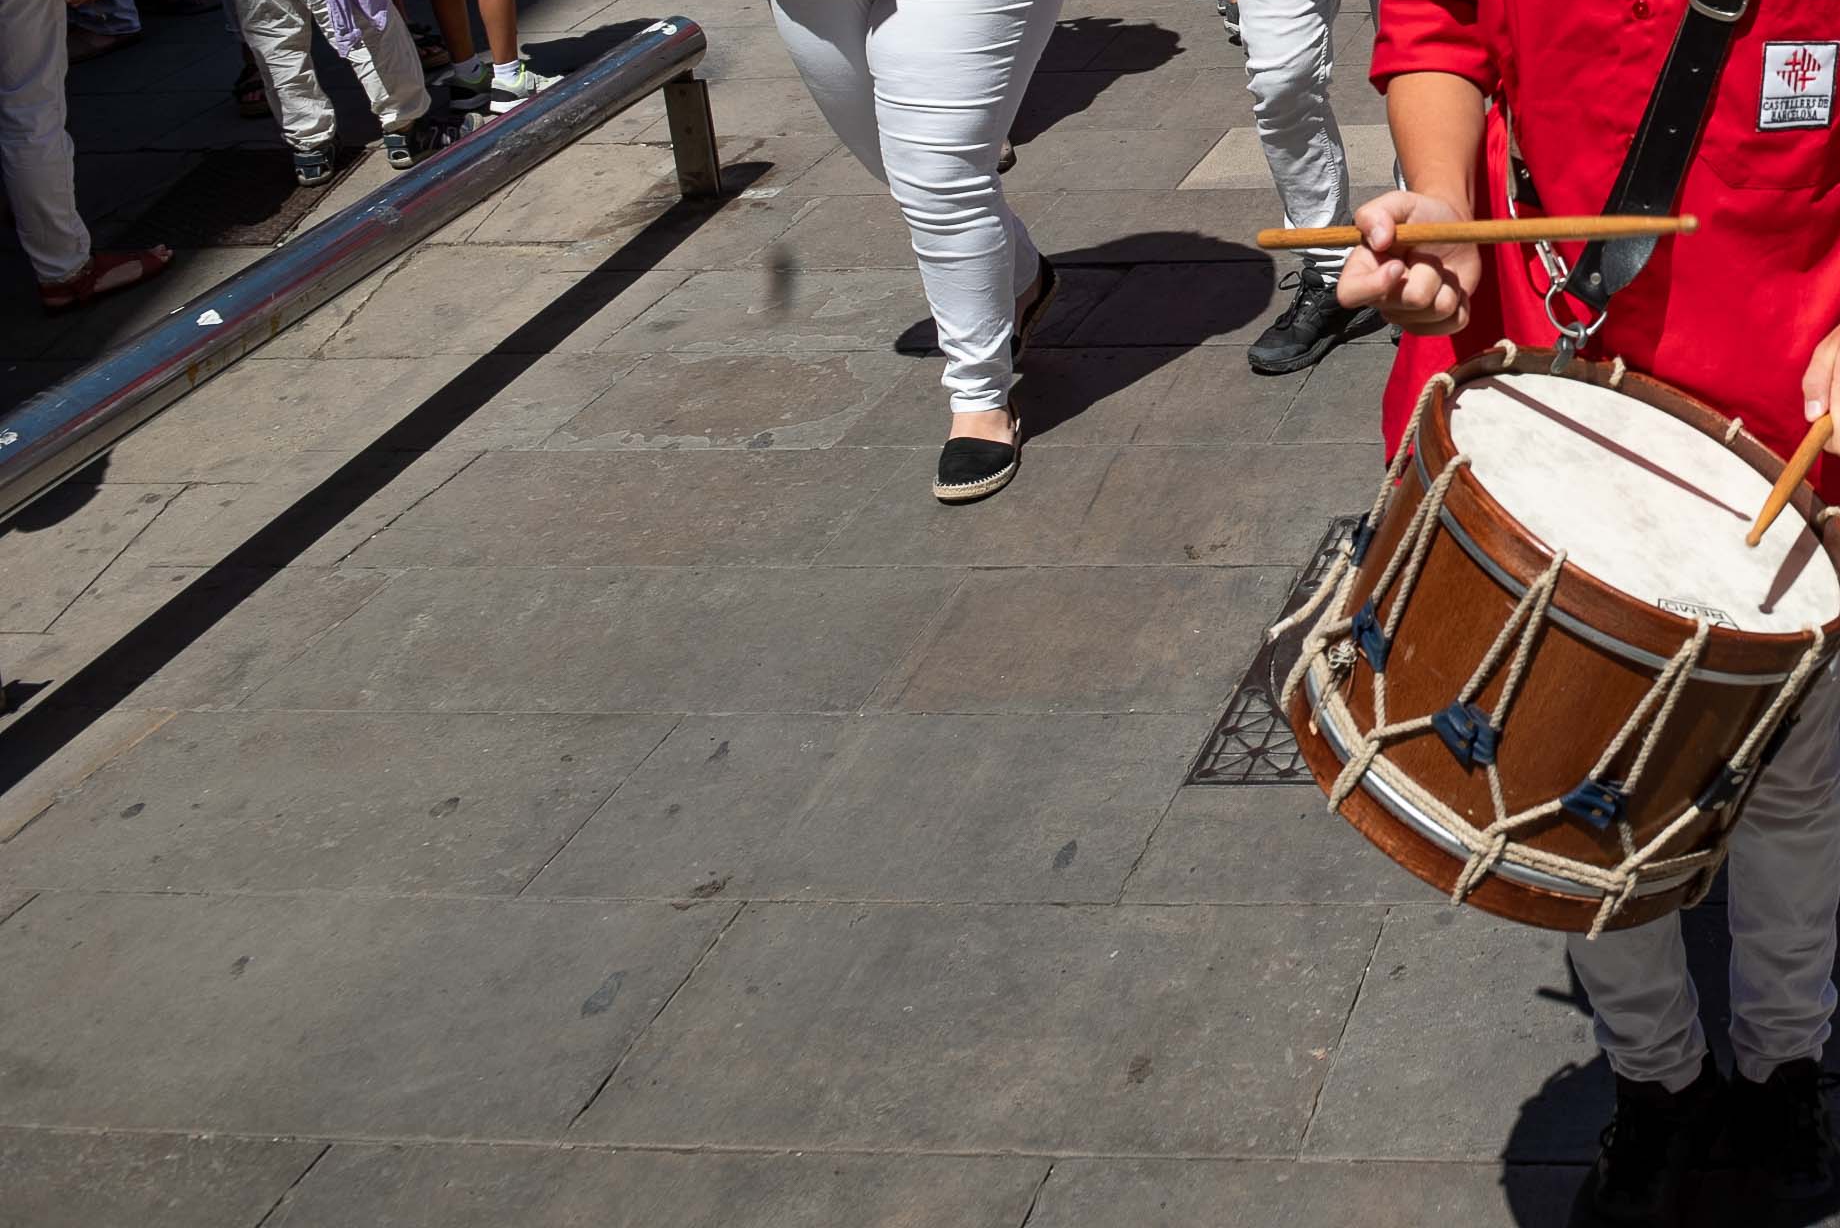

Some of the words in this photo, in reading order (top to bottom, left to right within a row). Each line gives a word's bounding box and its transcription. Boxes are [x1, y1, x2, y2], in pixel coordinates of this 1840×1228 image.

[1762, 99, 1817, 111] CASTELLERS
[1817, 98, 1829, 109] DE
[1770, 110, 1818, 123] BARCELONA
